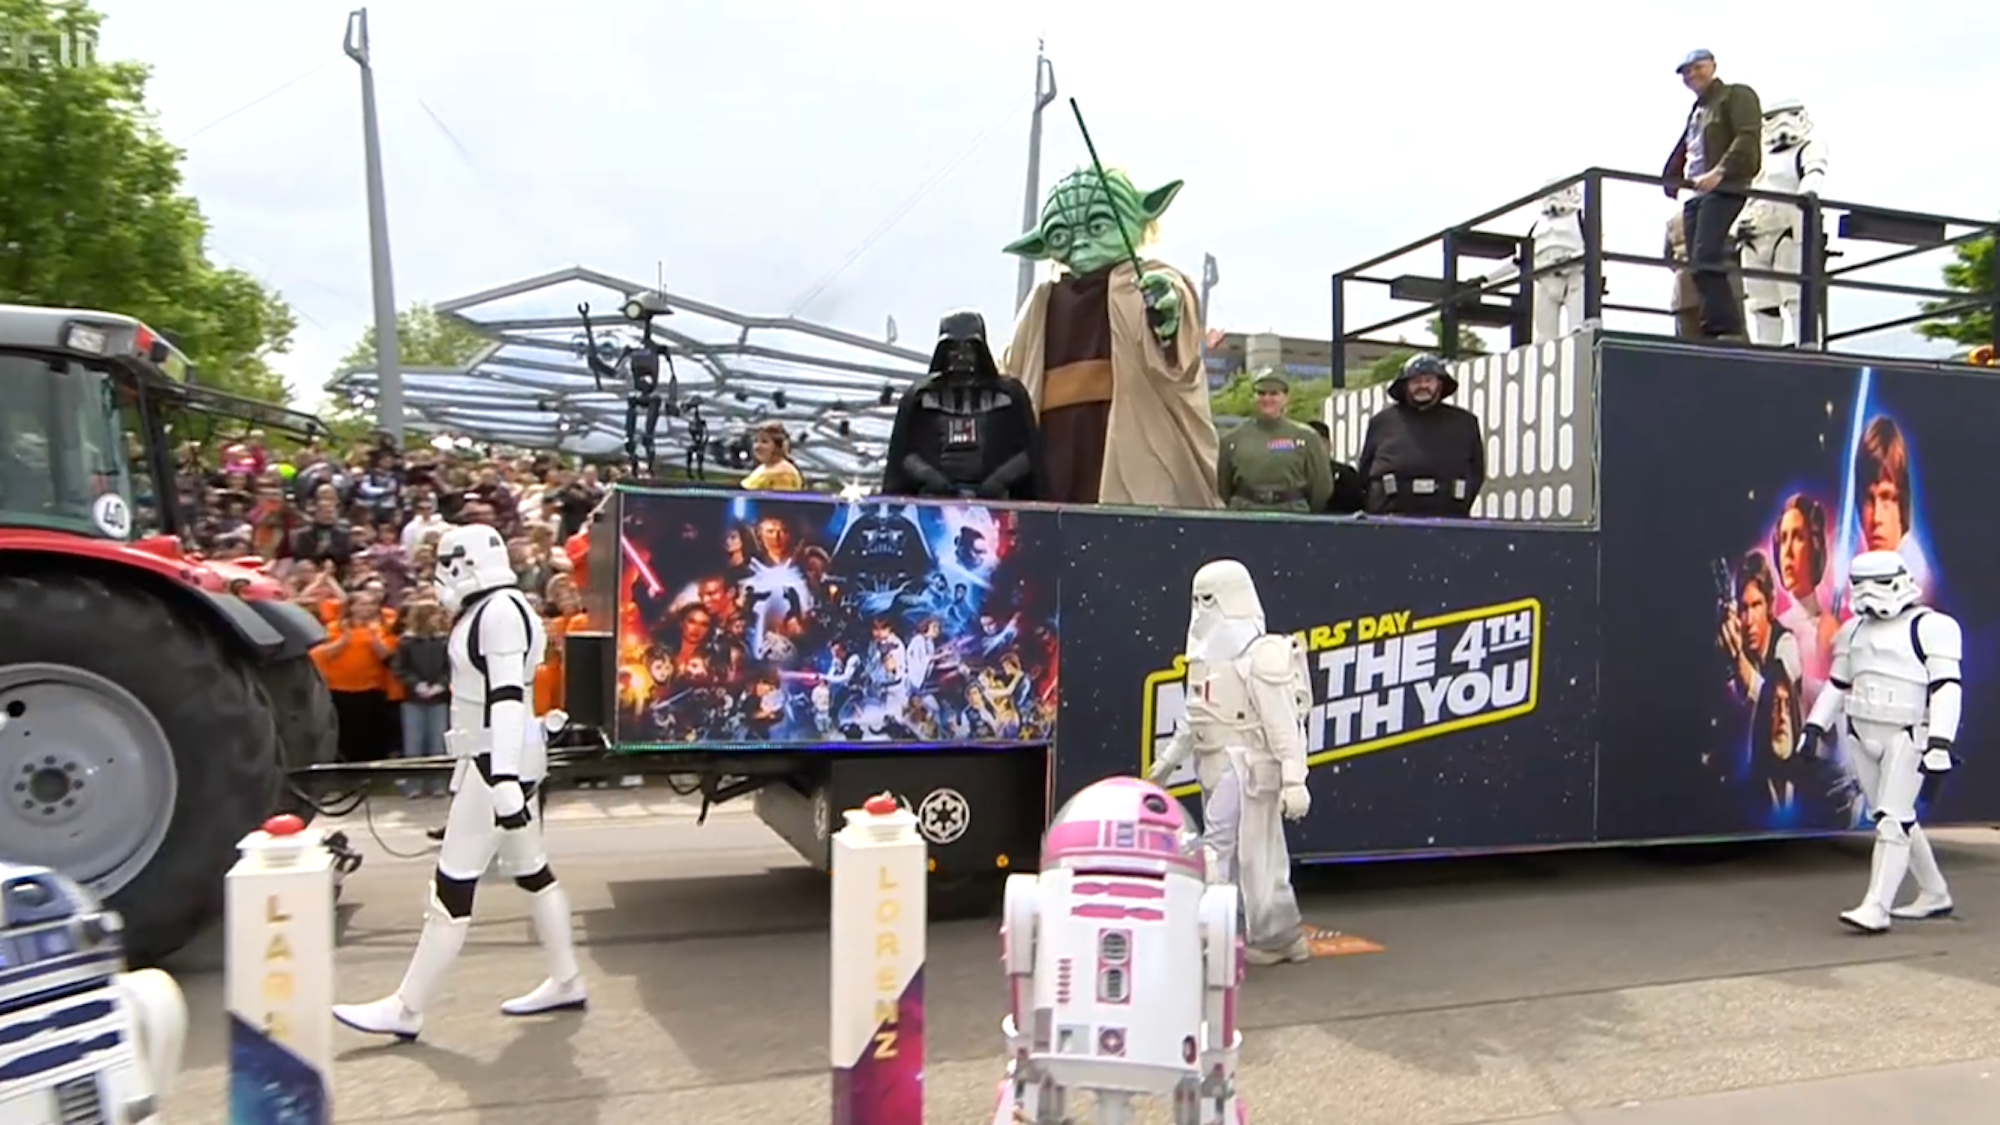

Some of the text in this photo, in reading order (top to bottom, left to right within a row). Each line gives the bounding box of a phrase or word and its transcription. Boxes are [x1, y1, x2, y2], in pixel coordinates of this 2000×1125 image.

[103, 501, 124, 530] 40
[1319, 610, 1531, 698] THE 4TH
[1357, 610, 1411, 641] DAY
[1306, 658, 1529, 754] ITH YOU
[873, 866, 900, 1060] LORENZ
